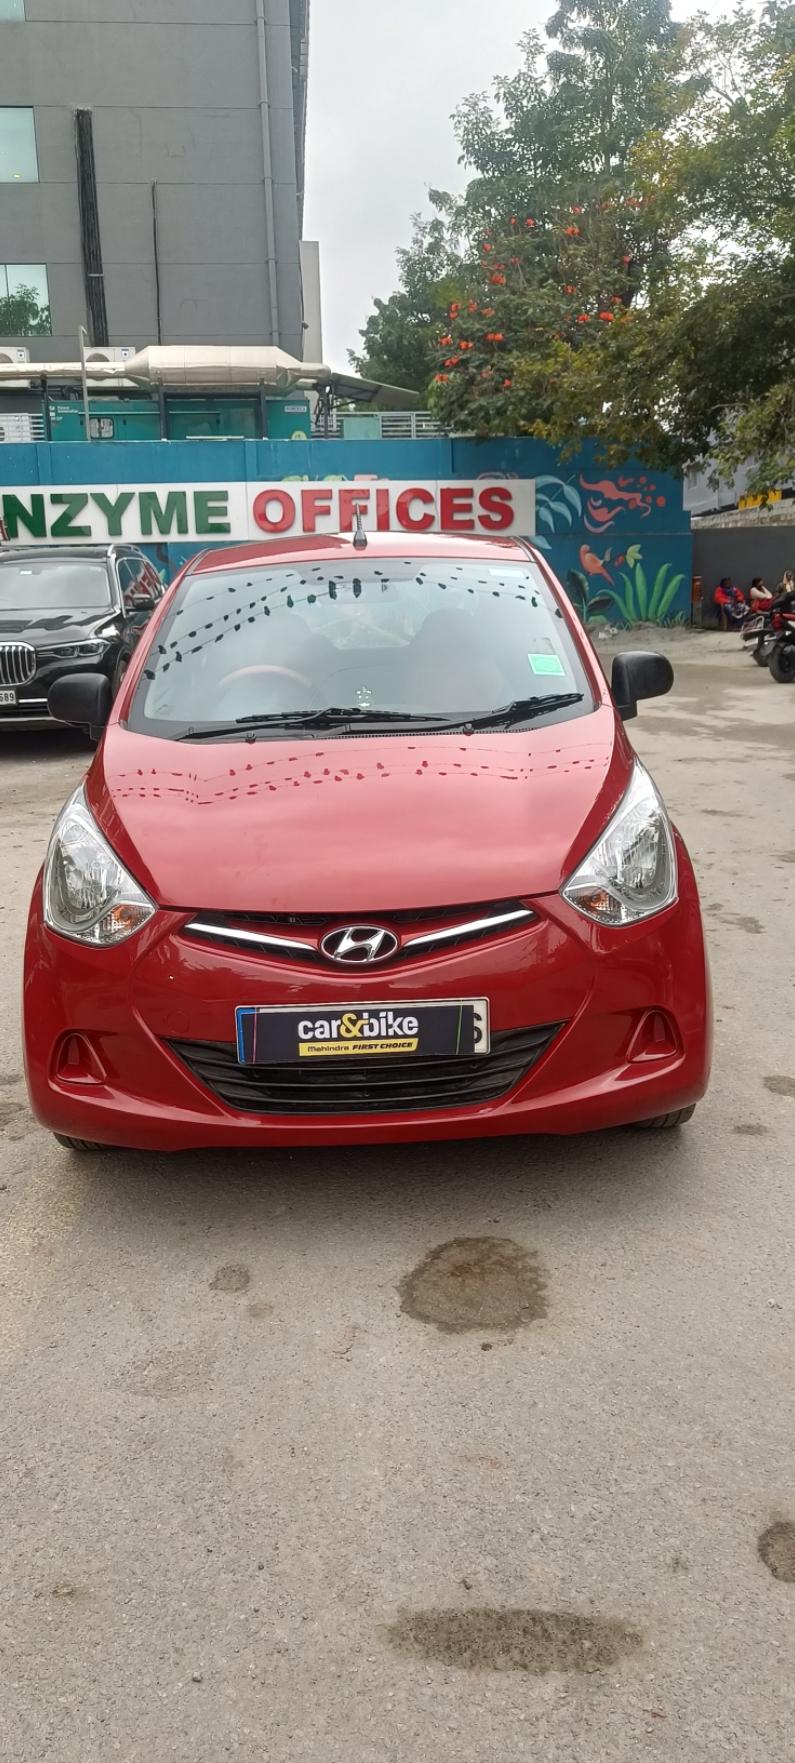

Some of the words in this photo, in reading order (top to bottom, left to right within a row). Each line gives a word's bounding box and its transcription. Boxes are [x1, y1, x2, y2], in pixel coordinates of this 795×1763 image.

[253, 486, 514, 533] OFFICES
[298, 1011, 419, 1039] car&bike
[307, 1045, 350, 1053] Mahindra
